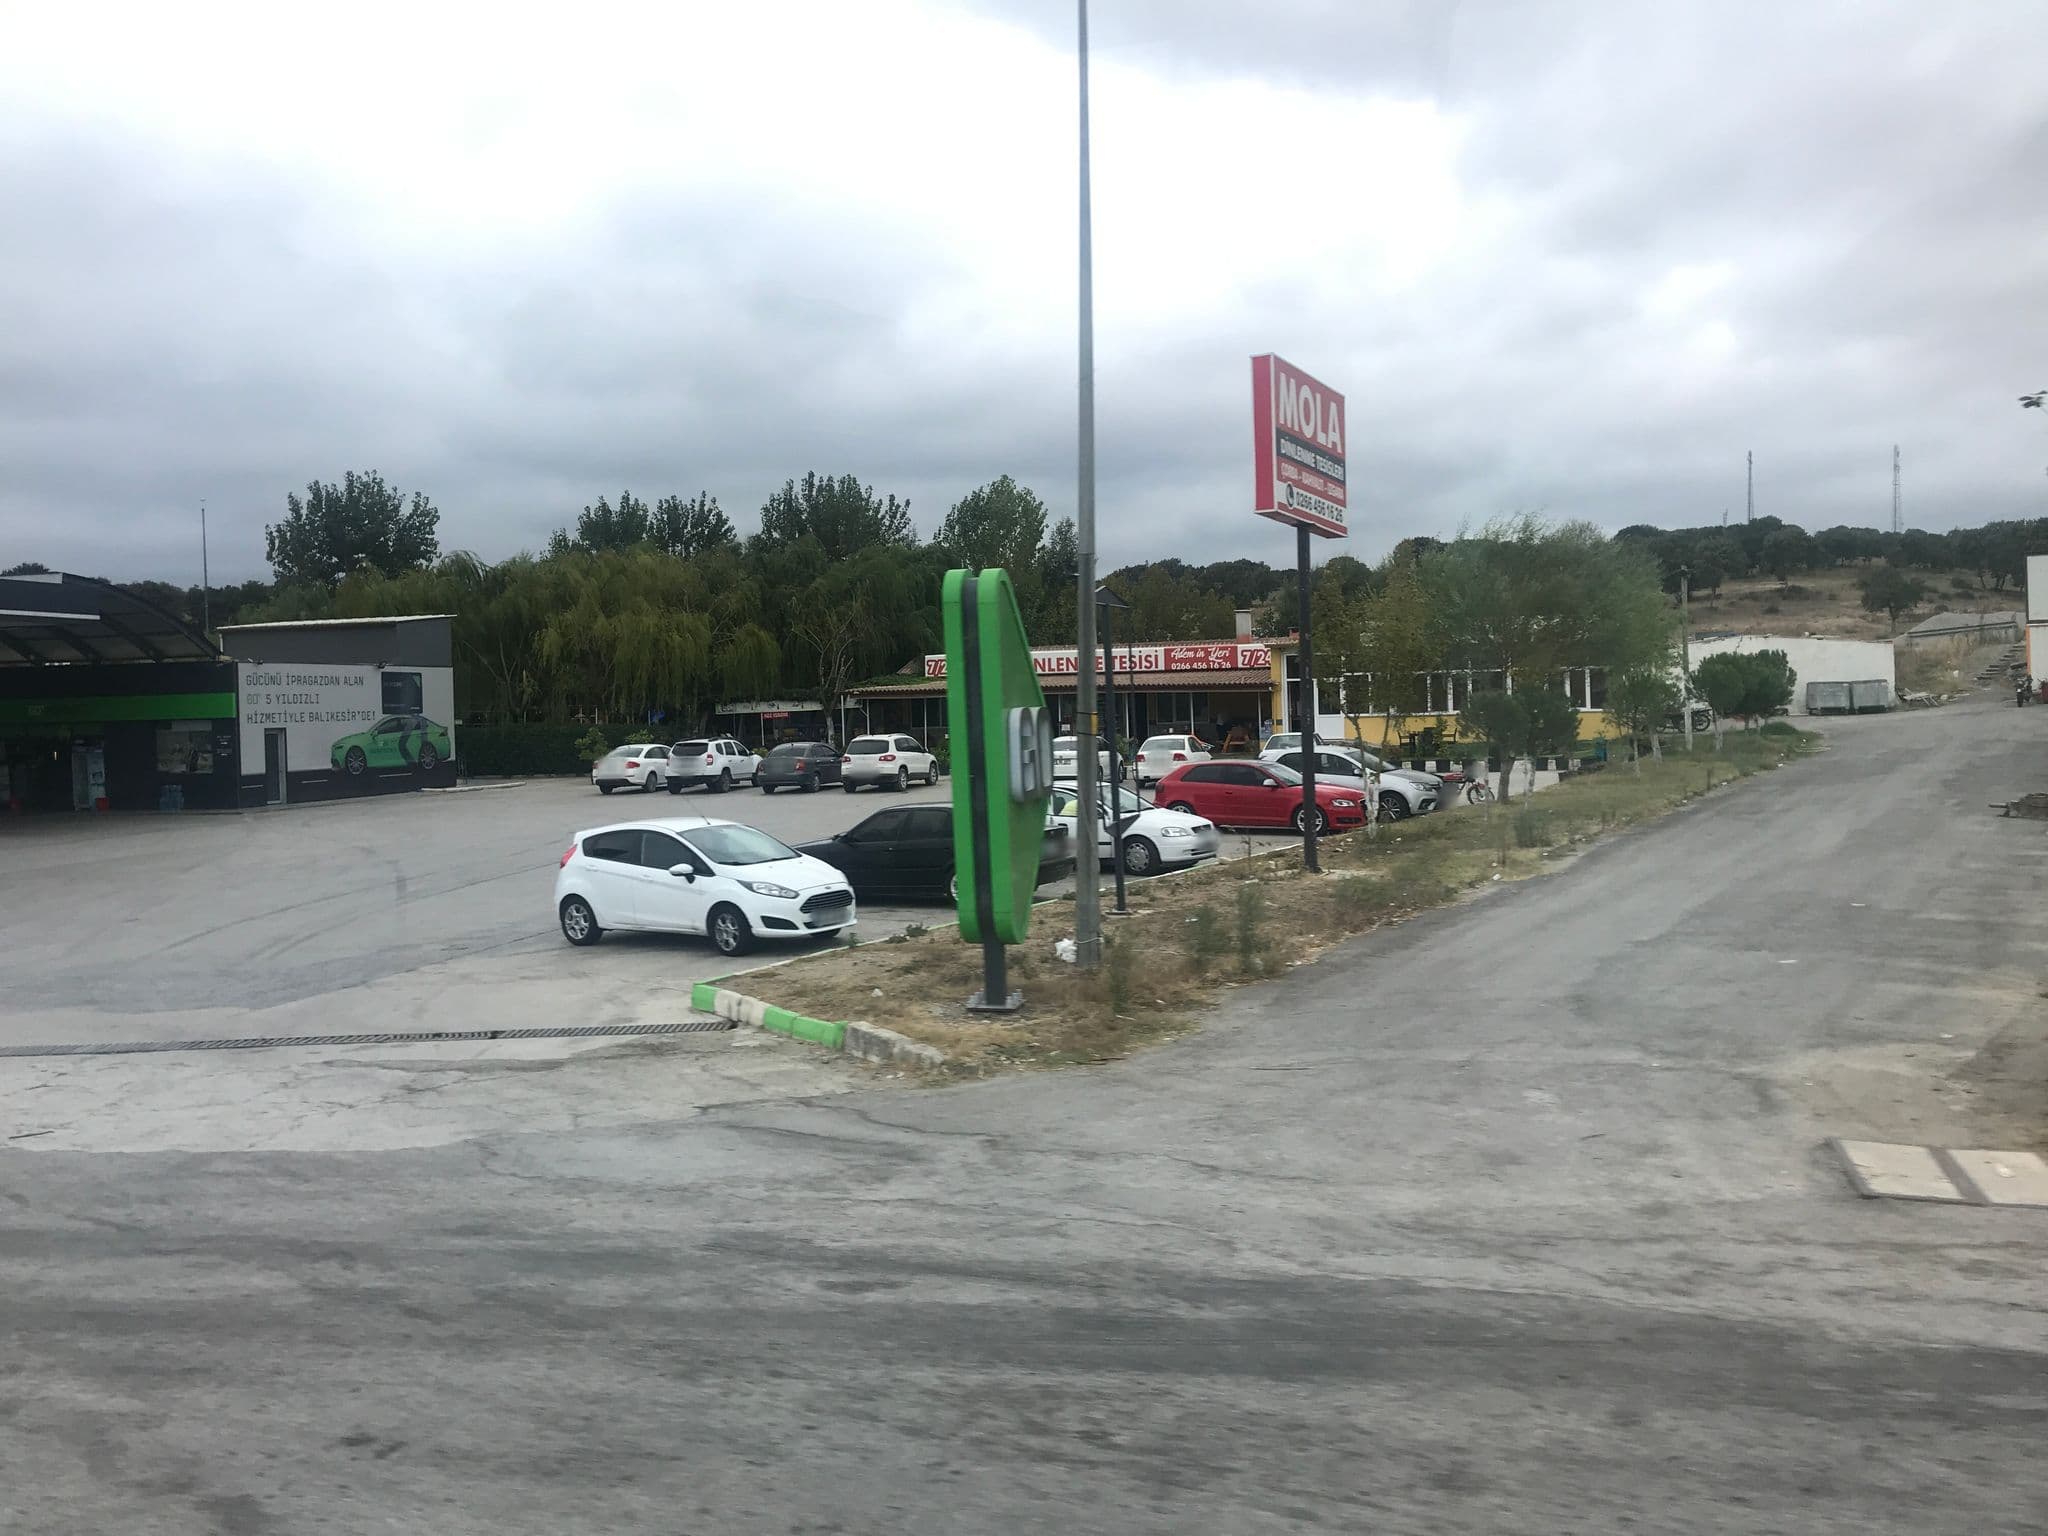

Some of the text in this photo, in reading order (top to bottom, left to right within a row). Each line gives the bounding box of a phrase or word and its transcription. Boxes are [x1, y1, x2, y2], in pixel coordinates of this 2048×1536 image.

[1279, 371, 1343, 454] MOLA
[1171, 648, 1194, 660] Adem
[1208, 647, 1231, 662] Yeri
[926, 659, 947, 676] 7/2
[1171, 662, 1190, 670] 0266
[1192, 662, 1207, 670] 456
[1221, 661, 1231, 669] 26
[246, 671, 364, 686] GÜCÜNÜ İPRAGAZDAN ALAN
[265, 693, 272, 705] 5
[275, 693, 320, 705] YILDIZLI
[247, 710, 305, 724] HİZMETİYLE
